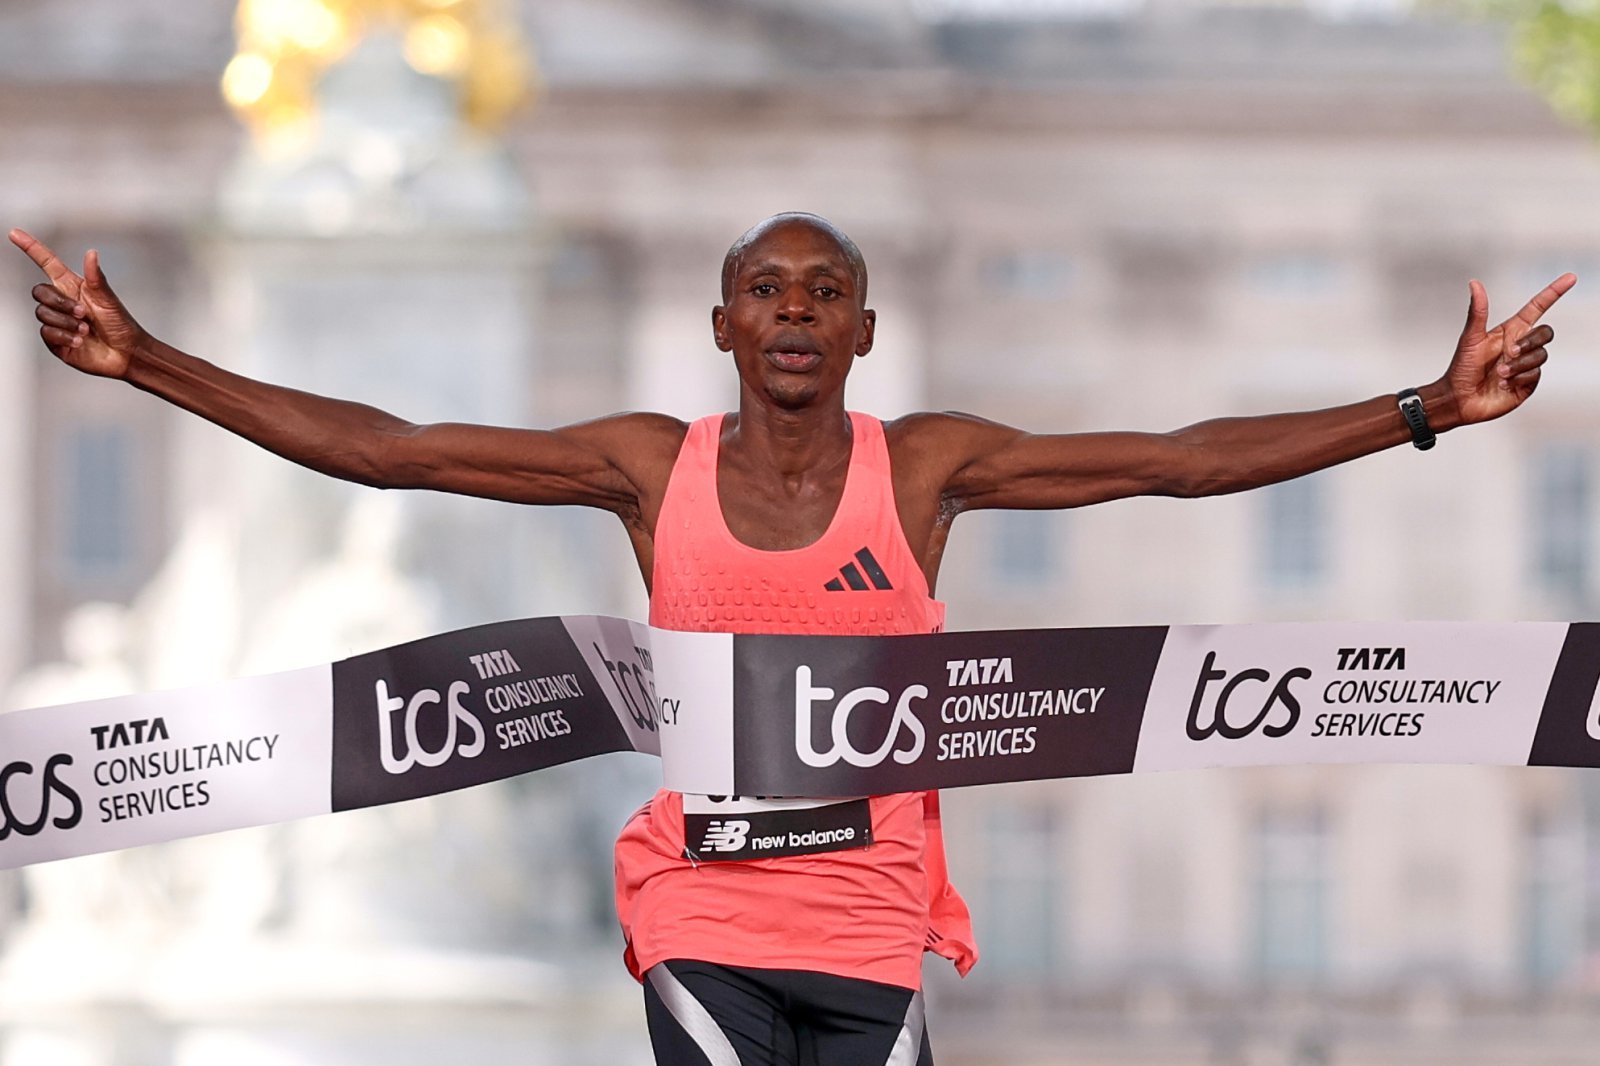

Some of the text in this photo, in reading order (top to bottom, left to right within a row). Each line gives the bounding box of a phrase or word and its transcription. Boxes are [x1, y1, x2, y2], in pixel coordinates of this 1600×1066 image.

[469, 649, 521, 680] TATA
[946, 657, 1014, 687] TATA
[1336, 648, 1406, 671] TATA
[484, 673, 585, 715] CONSULTANCY
[941, 687, 1106, 724] CONSULTANCY
[1185, 650, 1312, 742] tcs
[1323, 680, 1501, 704] CONSULTANCY
[90, 717, 170, 751] TATA
[375, 679, 486, 775] tcs
[495, 709, 572, 751] SERVICES
[795, 664, 929, 768] tcs
[1310, 712, 1425, 738] SERVICES
[94, 734, 280, 787] CONSULTANCY
[937, 726, 1038, 762] SERVICES
[0, 753, 83, 841] cs
[98, 780, 211, 823] SERVICES
[751, 827, 856, 851] new balance
